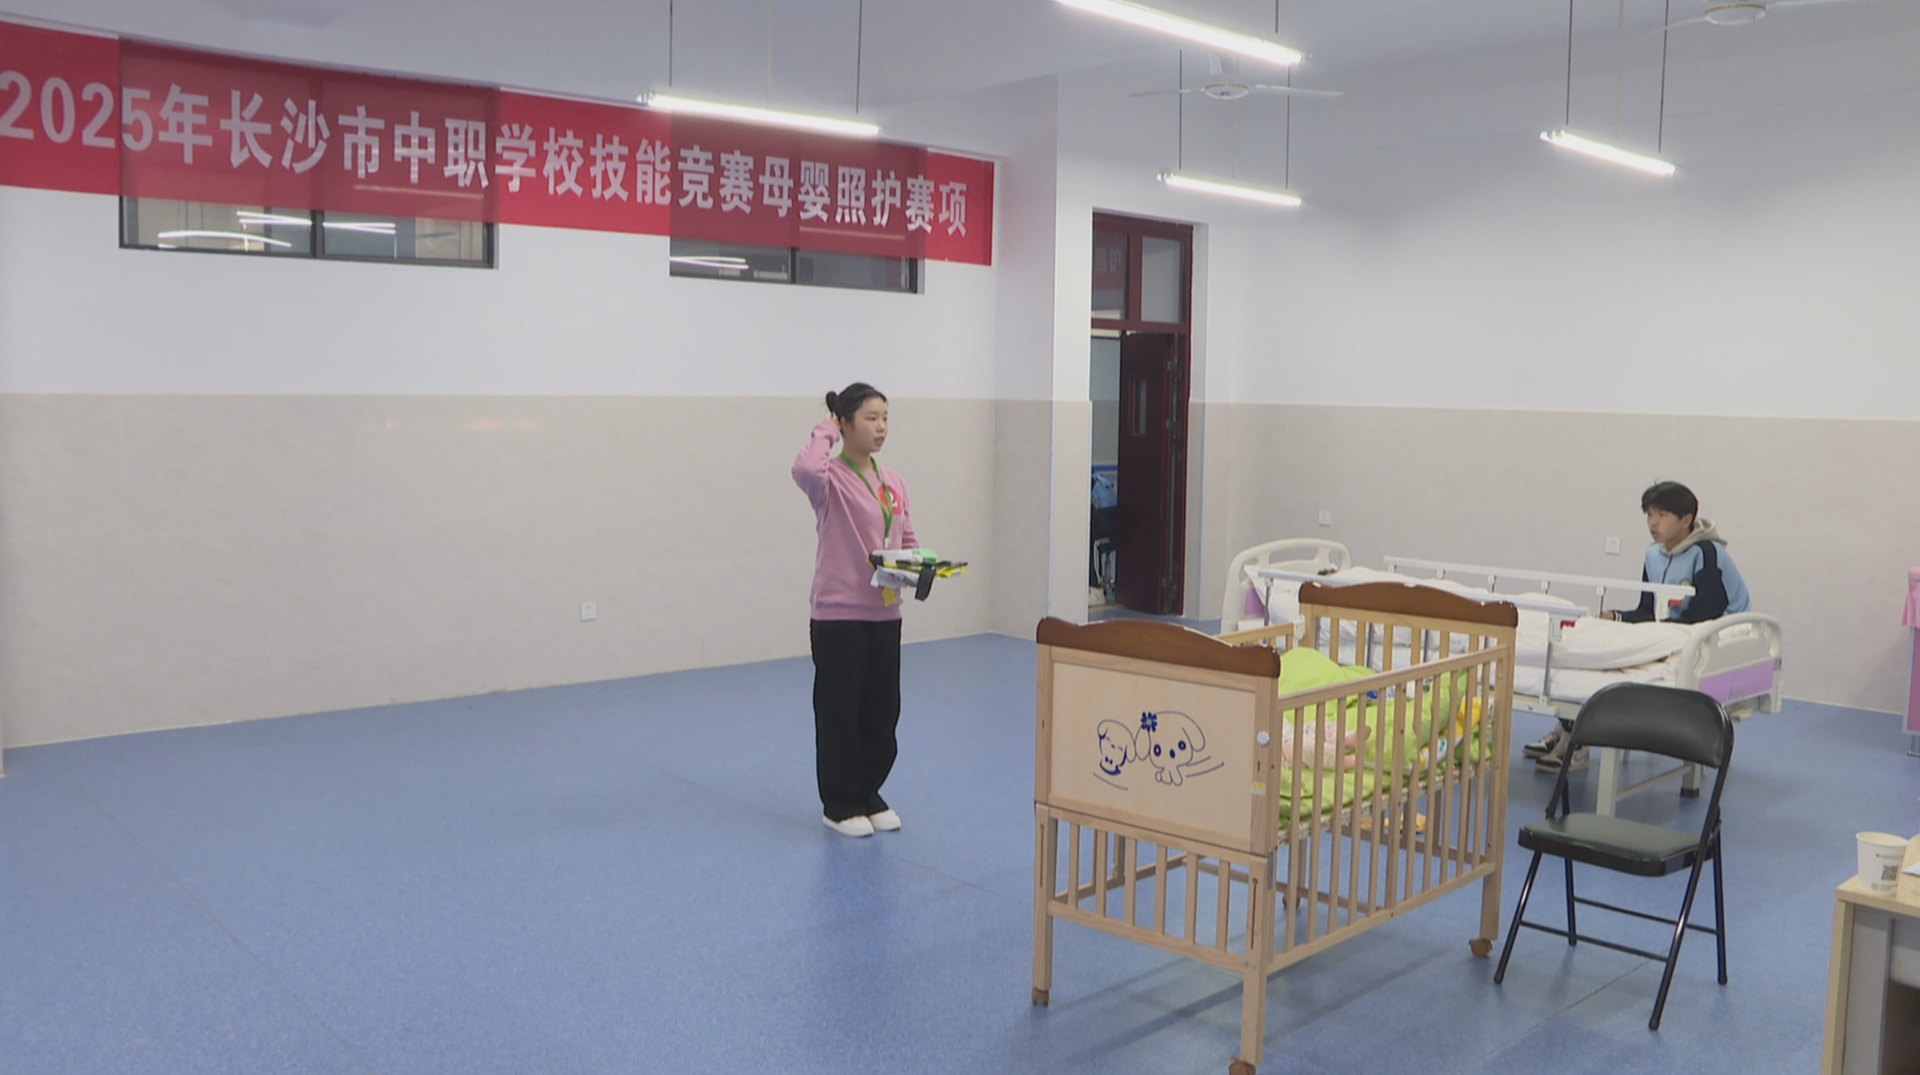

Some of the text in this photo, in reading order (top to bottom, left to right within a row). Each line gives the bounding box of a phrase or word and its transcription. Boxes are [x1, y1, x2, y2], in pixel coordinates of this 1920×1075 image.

[0, 70, 968, 237] 2025年长沙市中职学校技能竞赛母婴照护赛项
